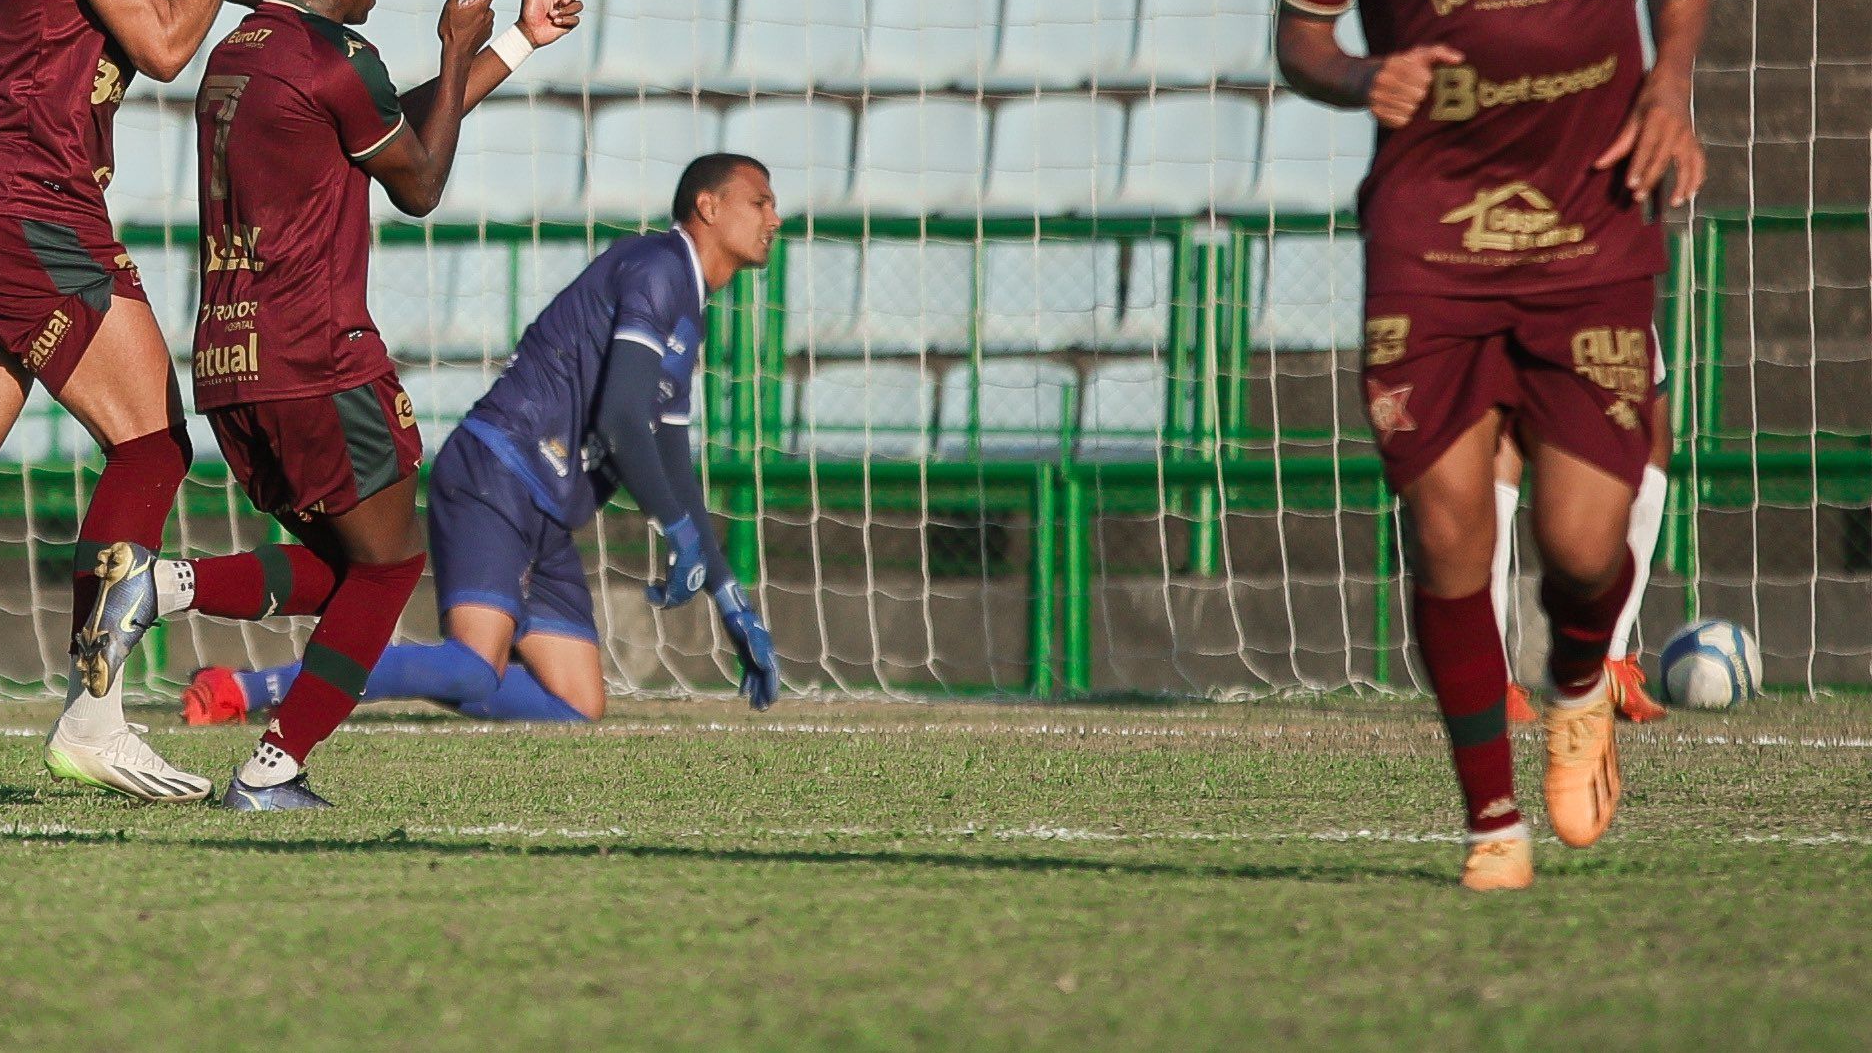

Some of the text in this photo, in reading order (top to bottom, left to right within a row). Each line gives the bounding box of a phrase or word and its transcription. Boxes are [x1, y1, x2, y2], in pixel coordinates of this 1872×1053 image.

[227, 28, 274, 45] Euro17
[1429, 64, 1479, 122] B
[198, 75, 252, 201] 7
[29, 309, 70, 367] atual
[195, 332, 259, 379] atual
